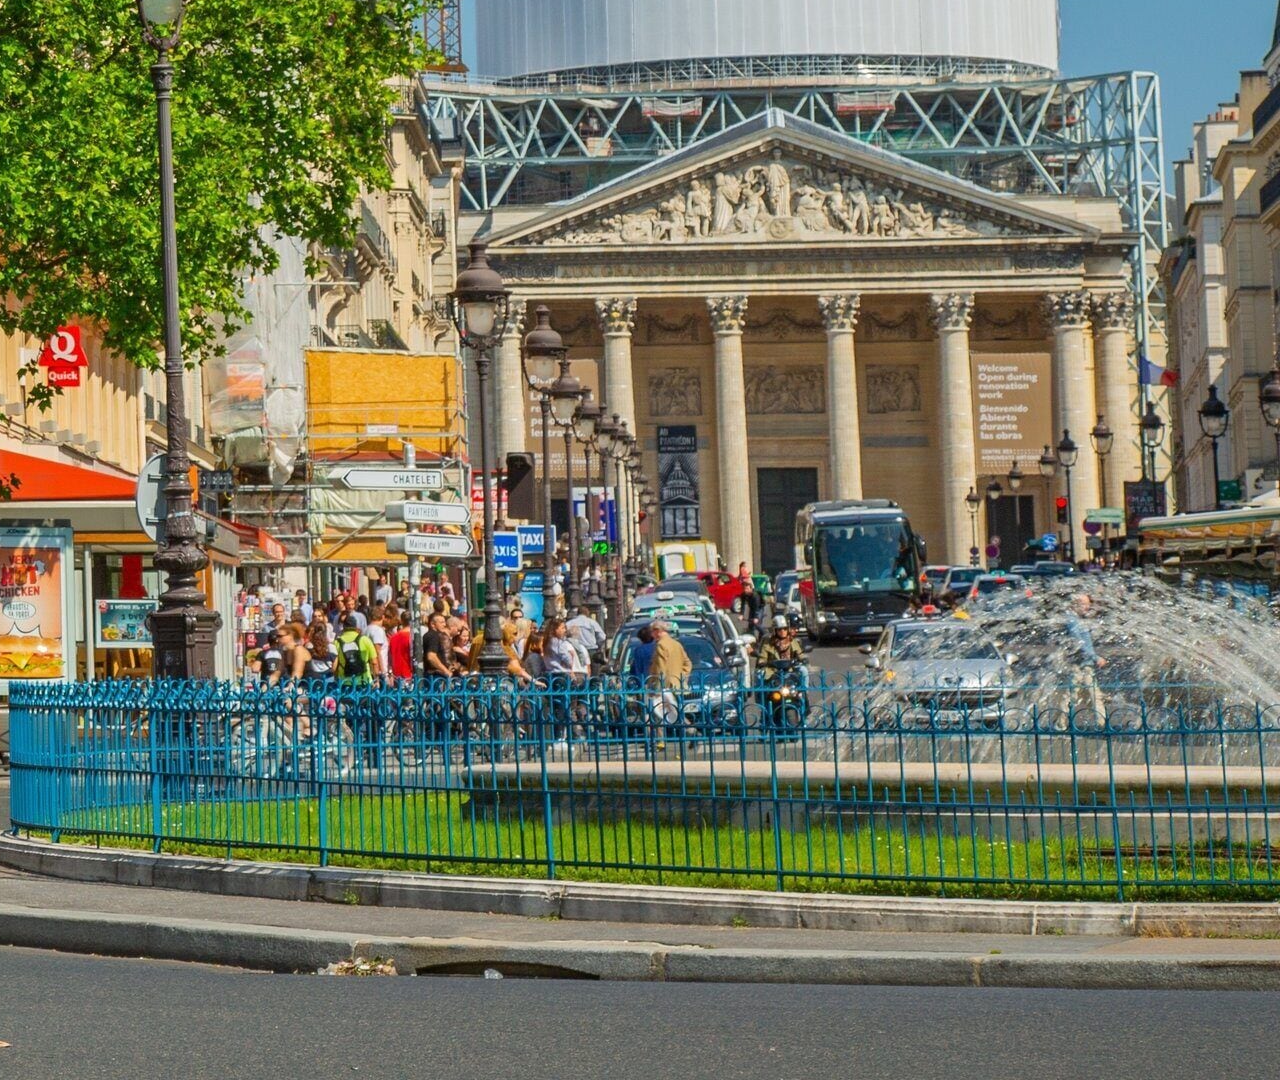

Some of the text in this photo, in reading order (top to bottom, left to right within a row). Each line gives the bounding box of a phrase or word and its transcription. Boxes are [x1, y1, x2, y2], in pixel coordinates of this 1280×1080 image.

[50, 331, 78, 363] Q
[978, 364, 1018, 372] Welcome
[48, 371, 78, 382] Quick
[979, 373, 1038, 383] Open during
[979, 382, 1030, 390] renovation
[979, 391, 1003, 399] work
[980, 405, 1029, 413] Bienvenido
[980, 414, 1018, 422] Abierto
[980, 423, 1018, 431] durante
[981, 432, 1023, 440] las obras
[393, 475, 437, 485] CHATELET
[409, 539, 428, 549] Mairie
[494, 546, 518, 557] AXIS
[9, 555, 33, 565] VERY
[1, 564, 38, 587] HOT
